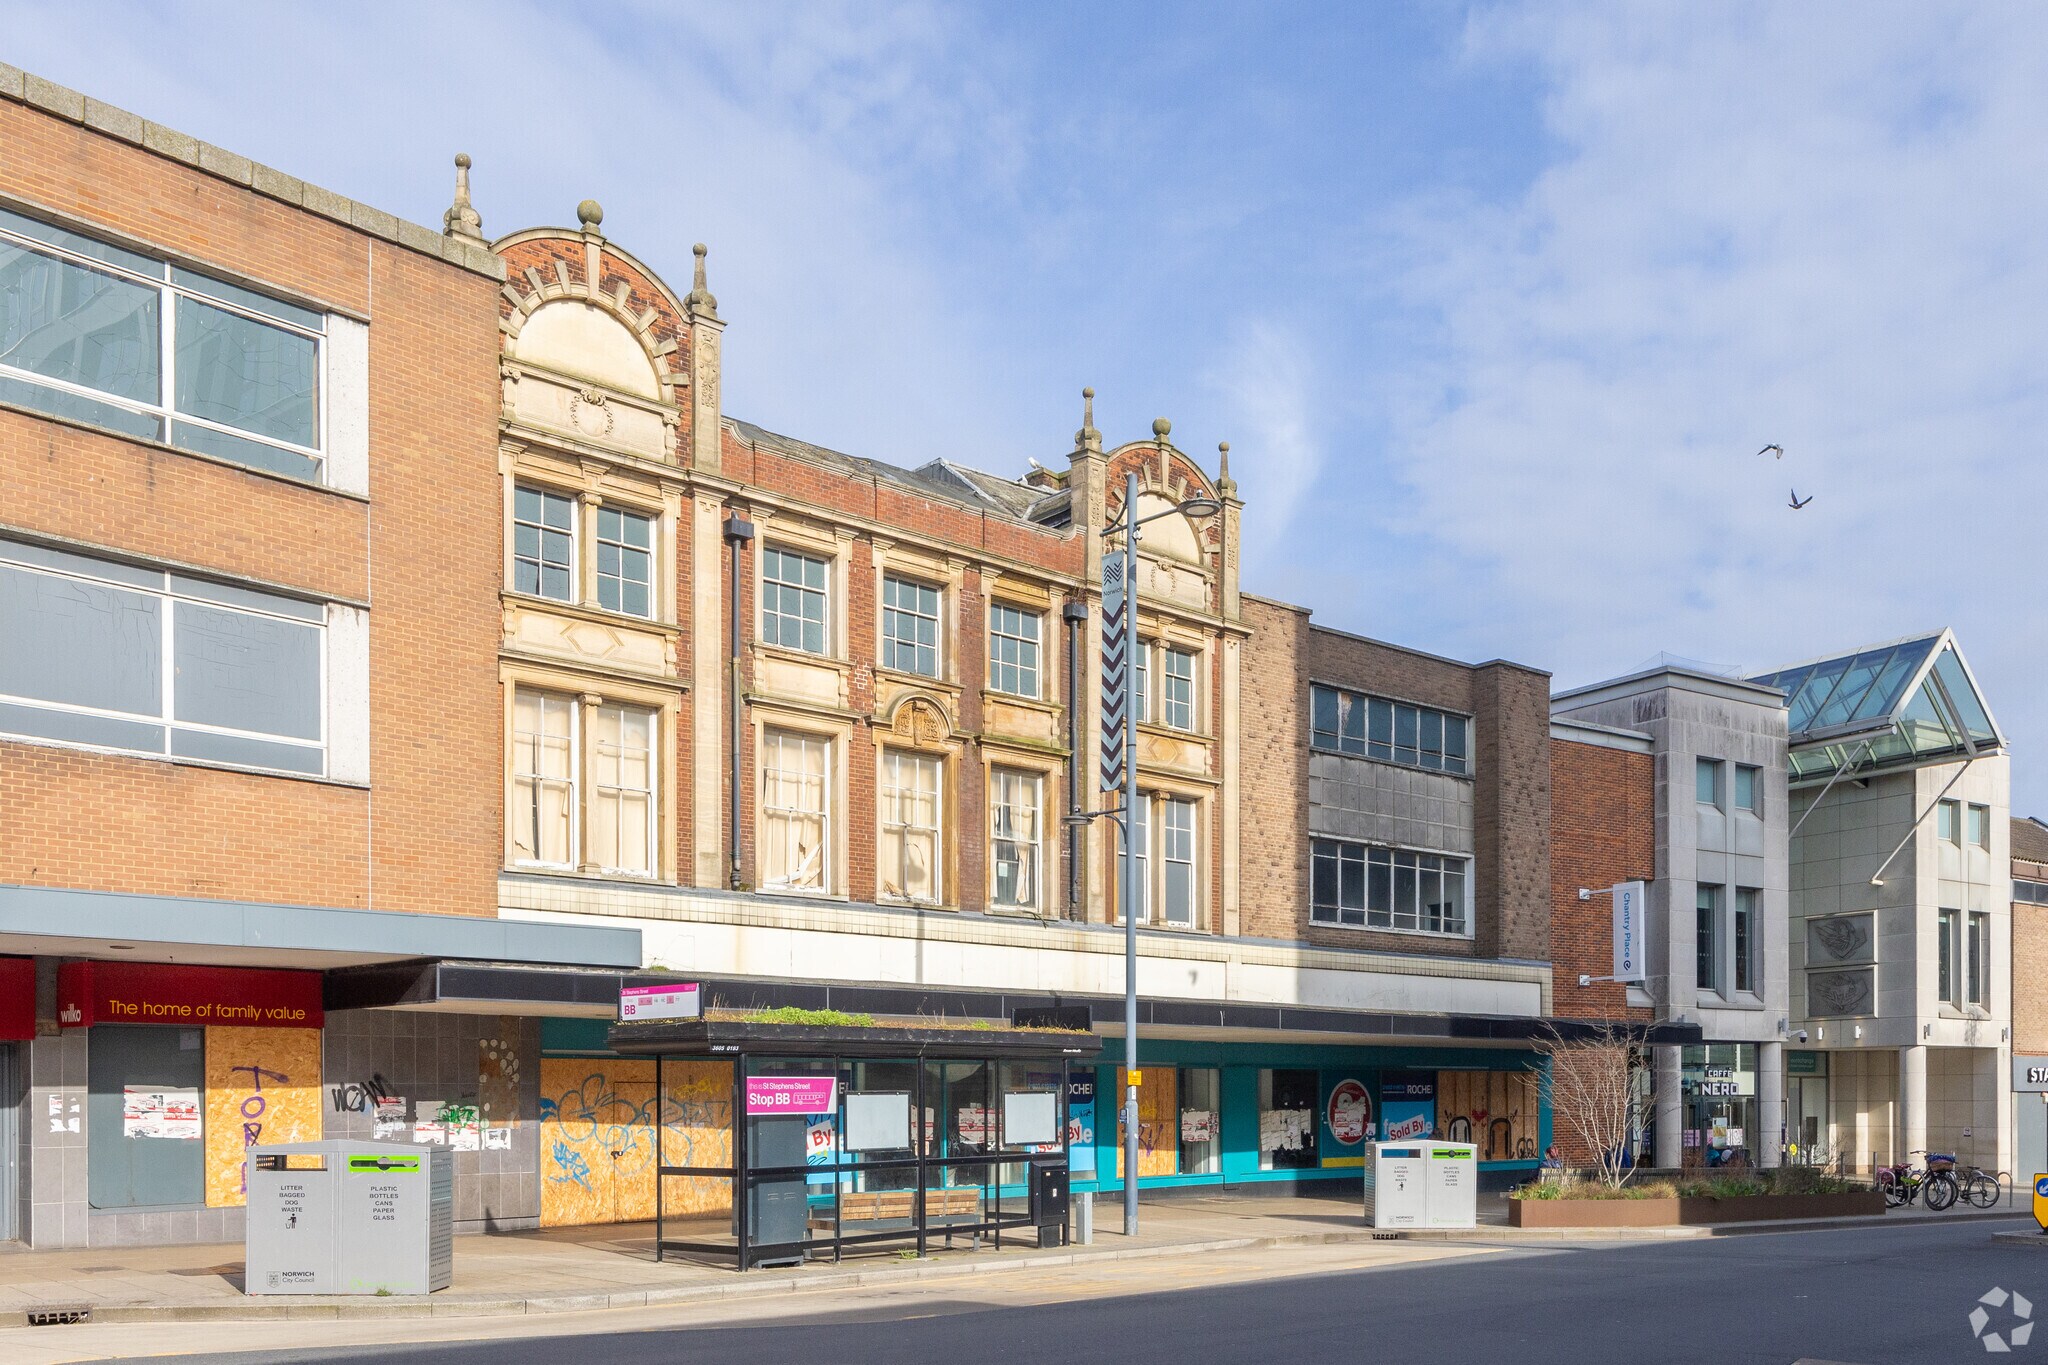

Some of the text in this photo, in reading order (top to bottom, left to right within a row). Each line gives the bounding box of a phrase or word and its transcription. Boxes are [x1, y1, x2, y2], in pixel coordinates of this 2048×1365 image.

[1103, 587, 1123, 597] Norwich
[1622, 892, 1630, 930] Chantry
[60, 1003, 82, 1023] wilko
[109, 1000, 306, 1022] The home of family value
[624, 1004, 636, 1015] BB
[762, 1082, 769, 1090] St
[770, 1082, 794, 1091] Stephens
[794, 1082, 811, 1090] Street
[1702, 1083, 1740, 1096] NERO
[749, 1092, 790, 1108] Stop BB
[812, 1128, 832, 1147] By
[1390, 1124, 1411, 1140] Sold
[1412, 1119, 1424, 1132] By
